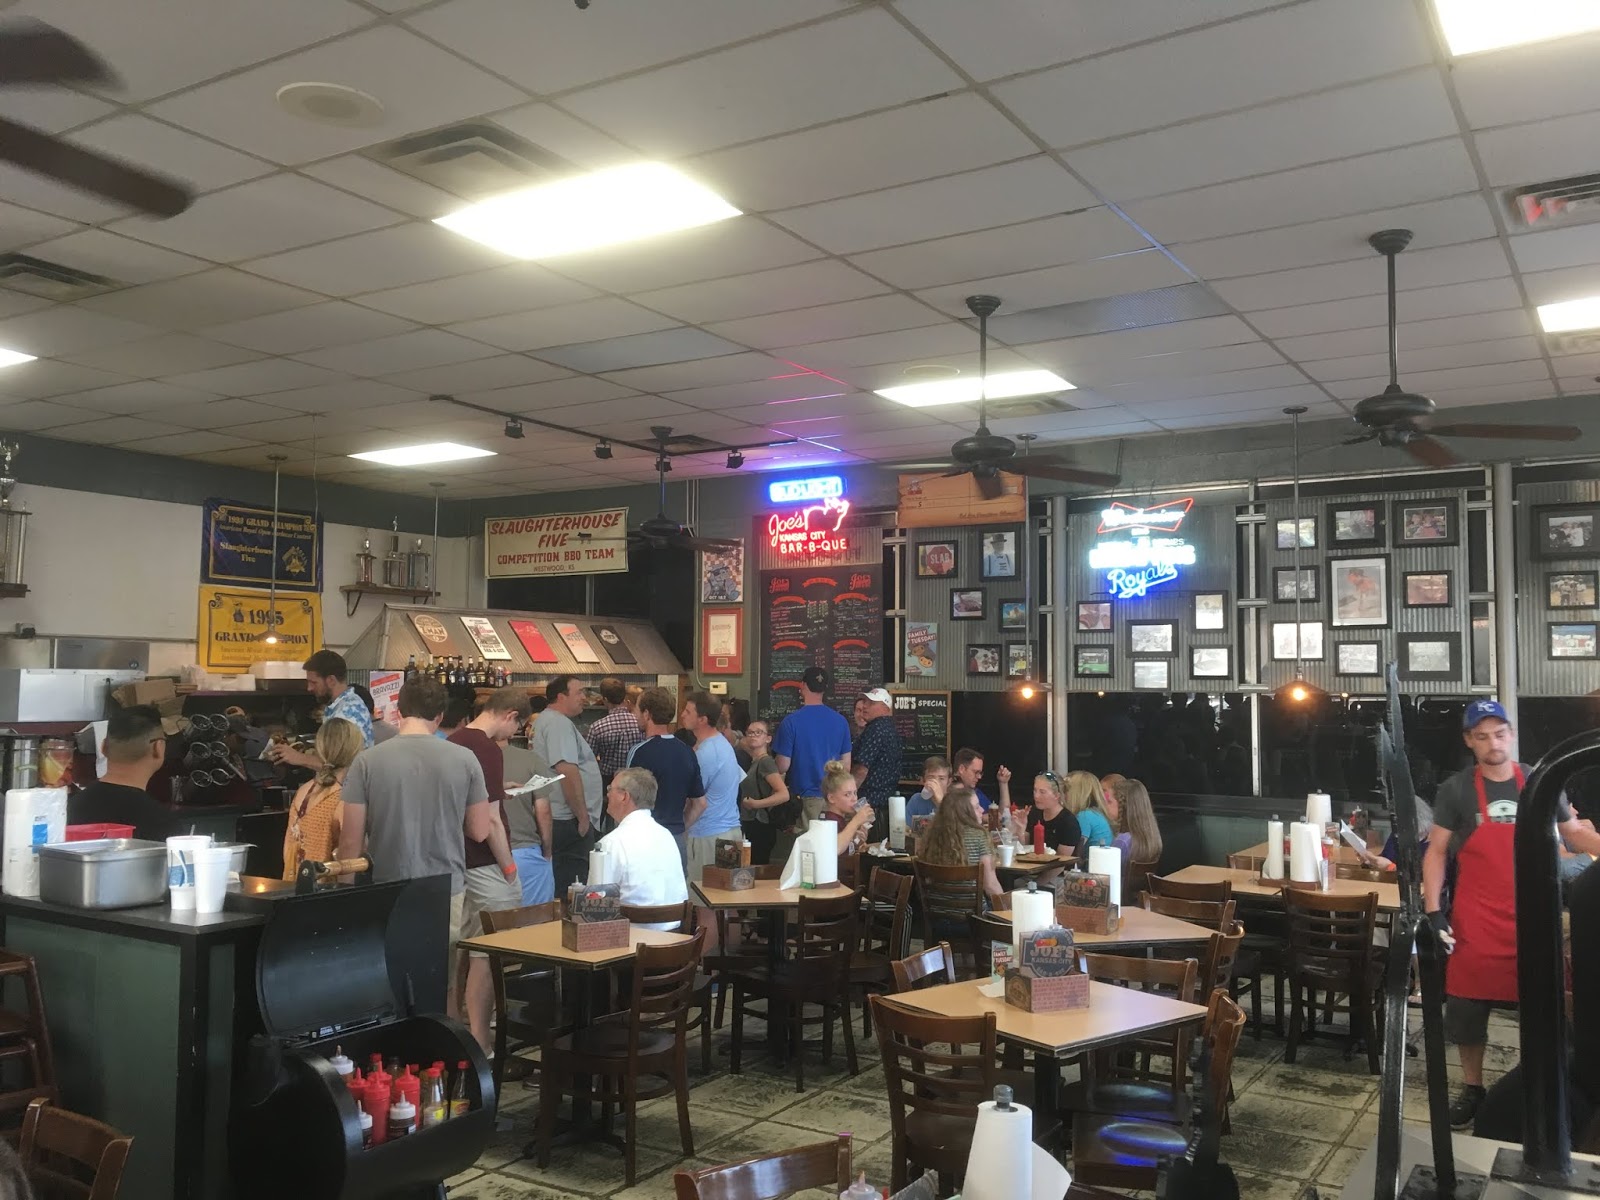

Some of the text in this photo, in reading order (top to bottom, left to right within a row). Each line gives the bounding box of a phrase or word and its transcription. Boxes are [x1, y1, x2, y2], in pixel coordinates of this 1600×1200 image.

[246, 518, 270, 527] GRAND
[490, 512, 623, 535] SLAUGHTERHOUSE
[769, 511, 805, 547] Joe's
[538, 533, 569, 548] FIVE
[779, 531, 826, 542] KANSAS CITY
[780, 538, 847, 554] BAR-B-QUE
[497, 548, 614, 565] COMPETITION BBQ TEAM
[1107, 560, 1177, 598] Royals
[249, 609, 285, 625] 1995
[215, 631, 255, 643] GRAND
[908, 629, 927, 638] FAMILY
[894, 696, 947, 710] JOE'S SPECIAL
[1477, 702, 1496, 712] KC
[1030, 944, 1075, 959] JOE'S
